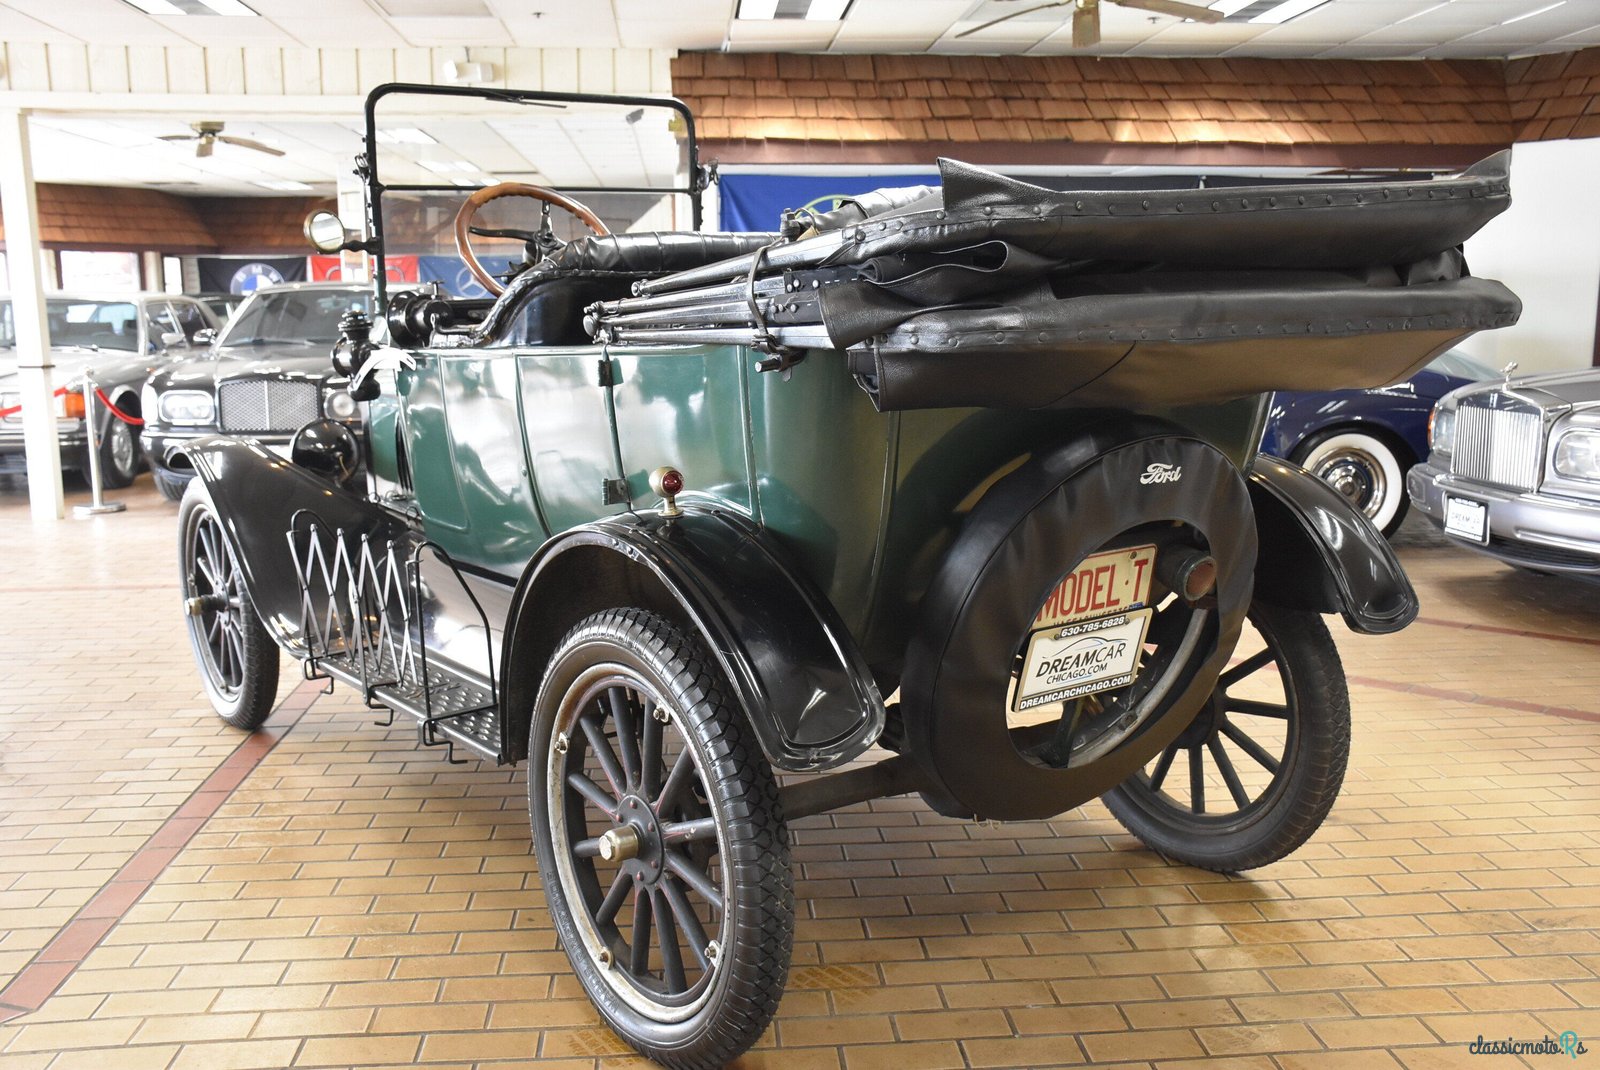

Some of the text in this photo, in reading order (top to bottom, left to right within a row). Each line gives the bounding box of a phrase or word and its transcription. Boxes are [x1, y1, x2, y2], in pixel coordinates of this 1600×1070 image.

[235, 263, 281, 283] BMW
[1139, 462, 1182, 485] Ford
[1061, 616, 1125, 637] 630-785-6828
[1036, 642, 1127, 678] DREAMCAR
[1046, 662, 1108, 685] CHICAGO.COM
[1020, 675, 1131, 710] DREAMCARCHICAGO.COM
